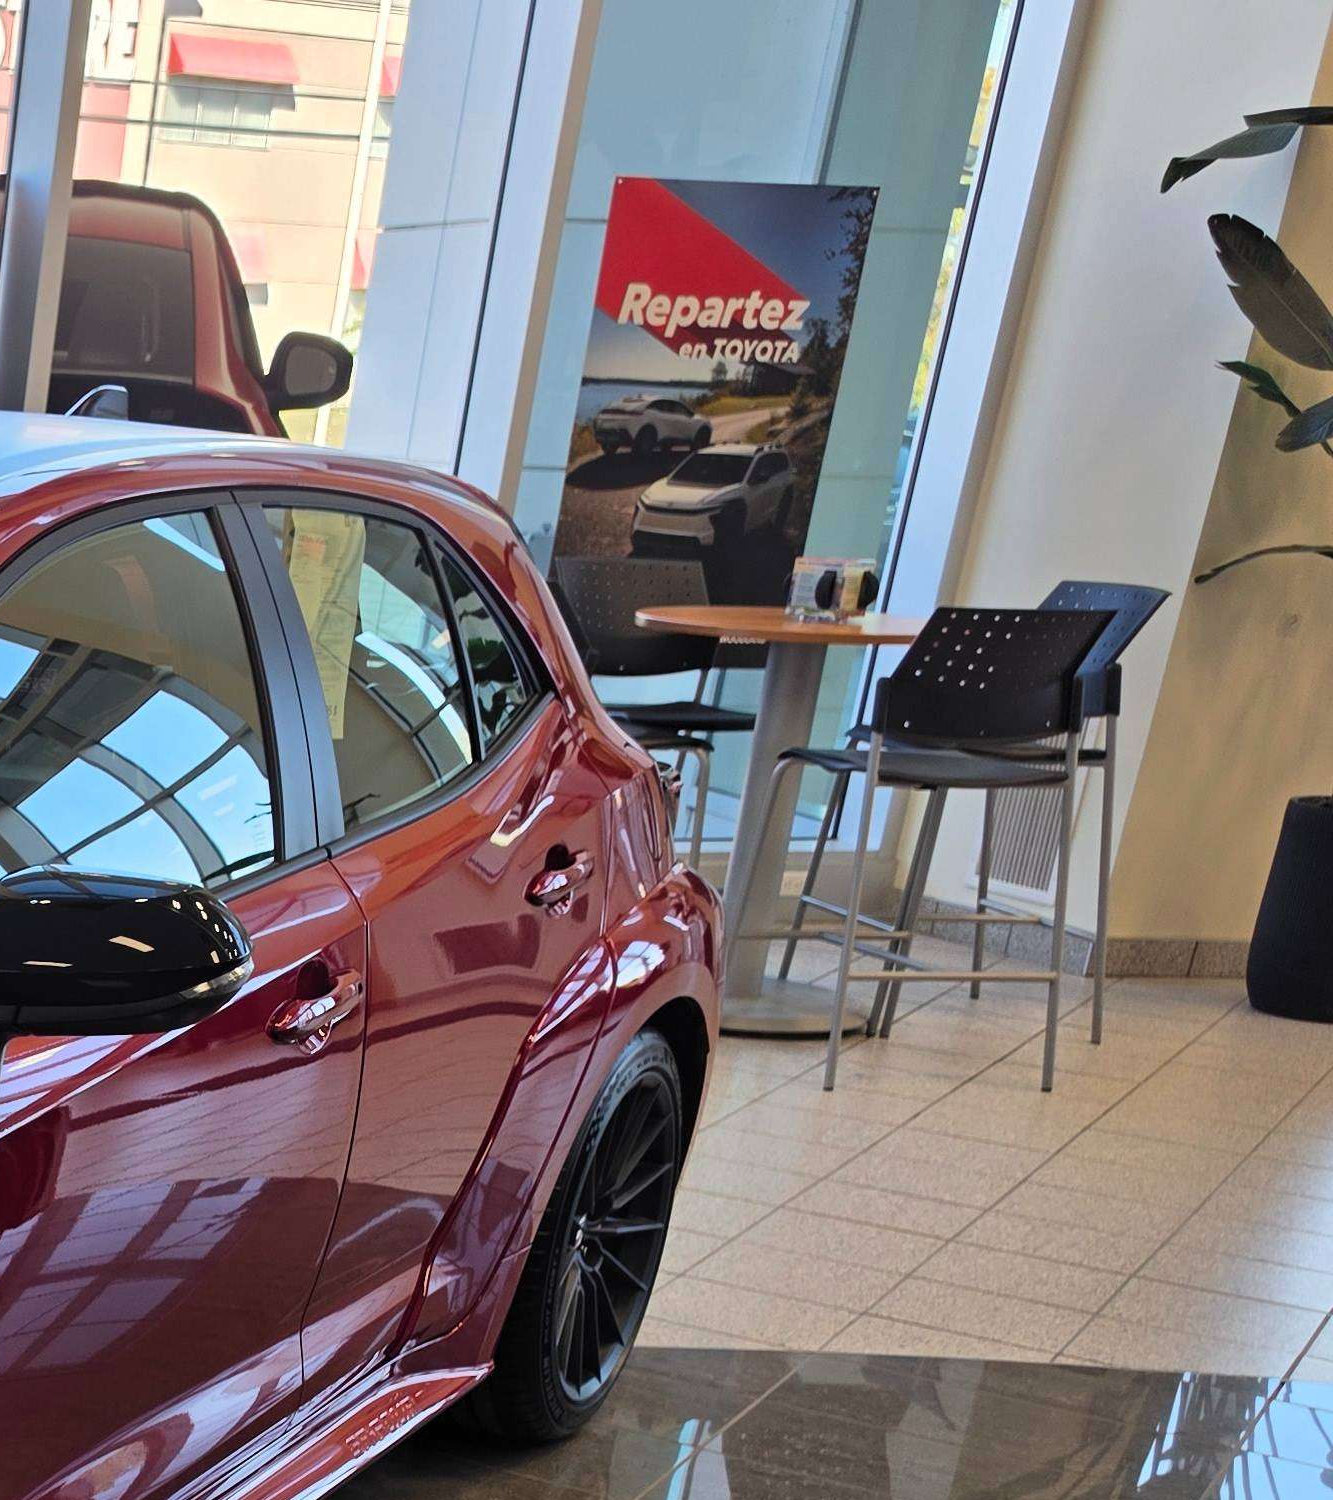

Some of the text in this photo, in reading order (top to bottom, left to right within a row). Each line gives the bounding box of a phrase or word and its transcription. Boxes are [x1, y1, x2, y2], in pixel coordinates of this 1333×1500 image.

[617, 281, 811, 338] Repartez
[679, 338, 801, 364] en TOYOTA
